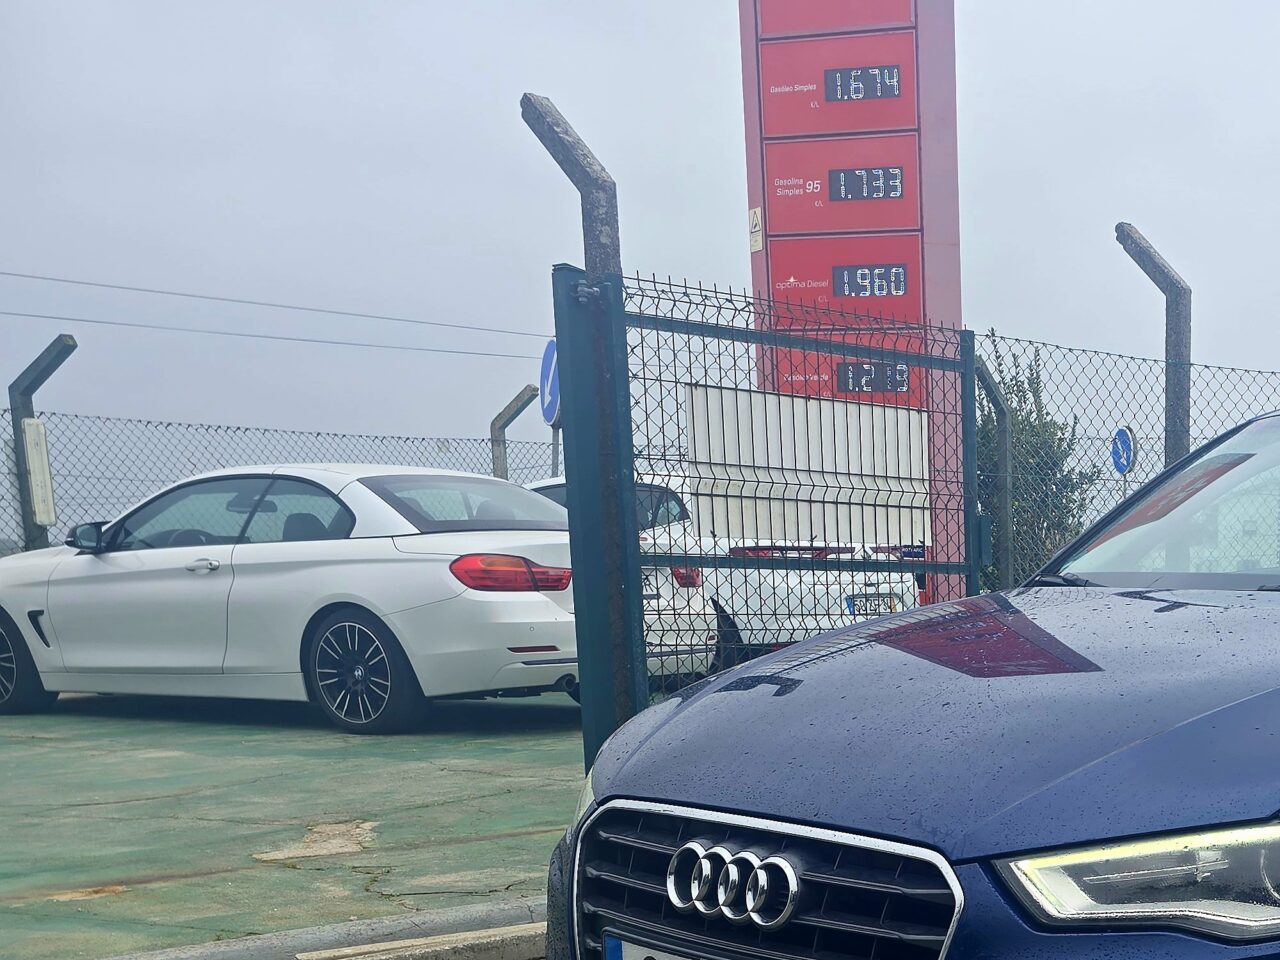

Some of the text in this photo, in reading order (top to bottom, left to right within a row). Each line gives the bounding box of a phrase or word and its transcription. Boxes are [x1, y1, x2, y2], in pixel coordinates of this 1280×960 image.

[794, 84, 817, 92] Simples
[836, 69, 899, 100] 1.674
[774, 178, 803, 186] Gasolina
[806, 180, 821, 193] 95
[840, 168, 901, 199] 1.733
[776, 187, 803, 196] Simples
[775, 279, 829, 291] optima Diesel
[843, 267, 905, 297] 1.960
